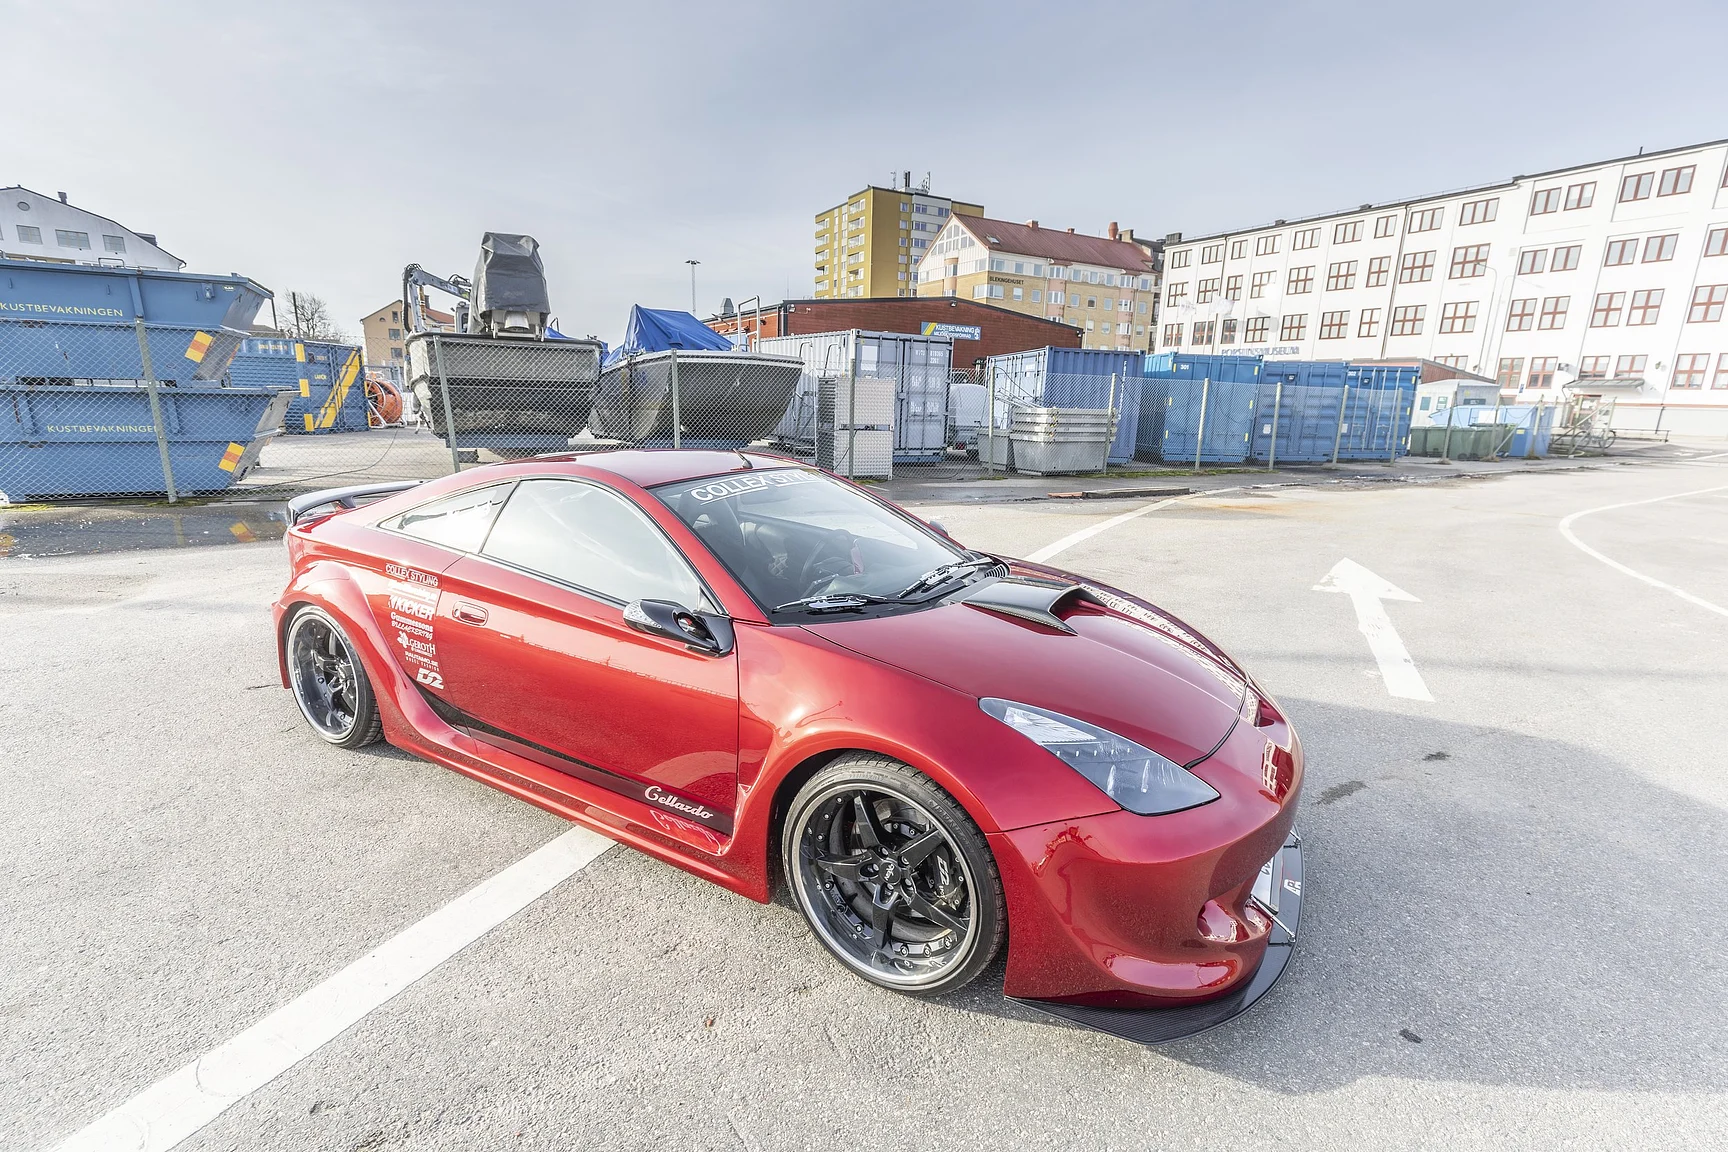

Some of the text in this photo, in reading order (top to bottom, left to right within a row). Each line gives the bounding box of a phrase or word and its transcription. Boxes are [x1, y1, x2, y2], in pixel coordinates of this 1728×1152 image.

[0, 302, 123, 317] KUSTBEVAKNINGEN
[47, 425, 157, 433] KUSTBEVAKNINGE
[690, 475, 770, 501] COLLEX
[385, 564, 439, 587] COLLEX STYLING
[394, 597, 435, 621] KICKER
[416, 667, 444, 690] D2
